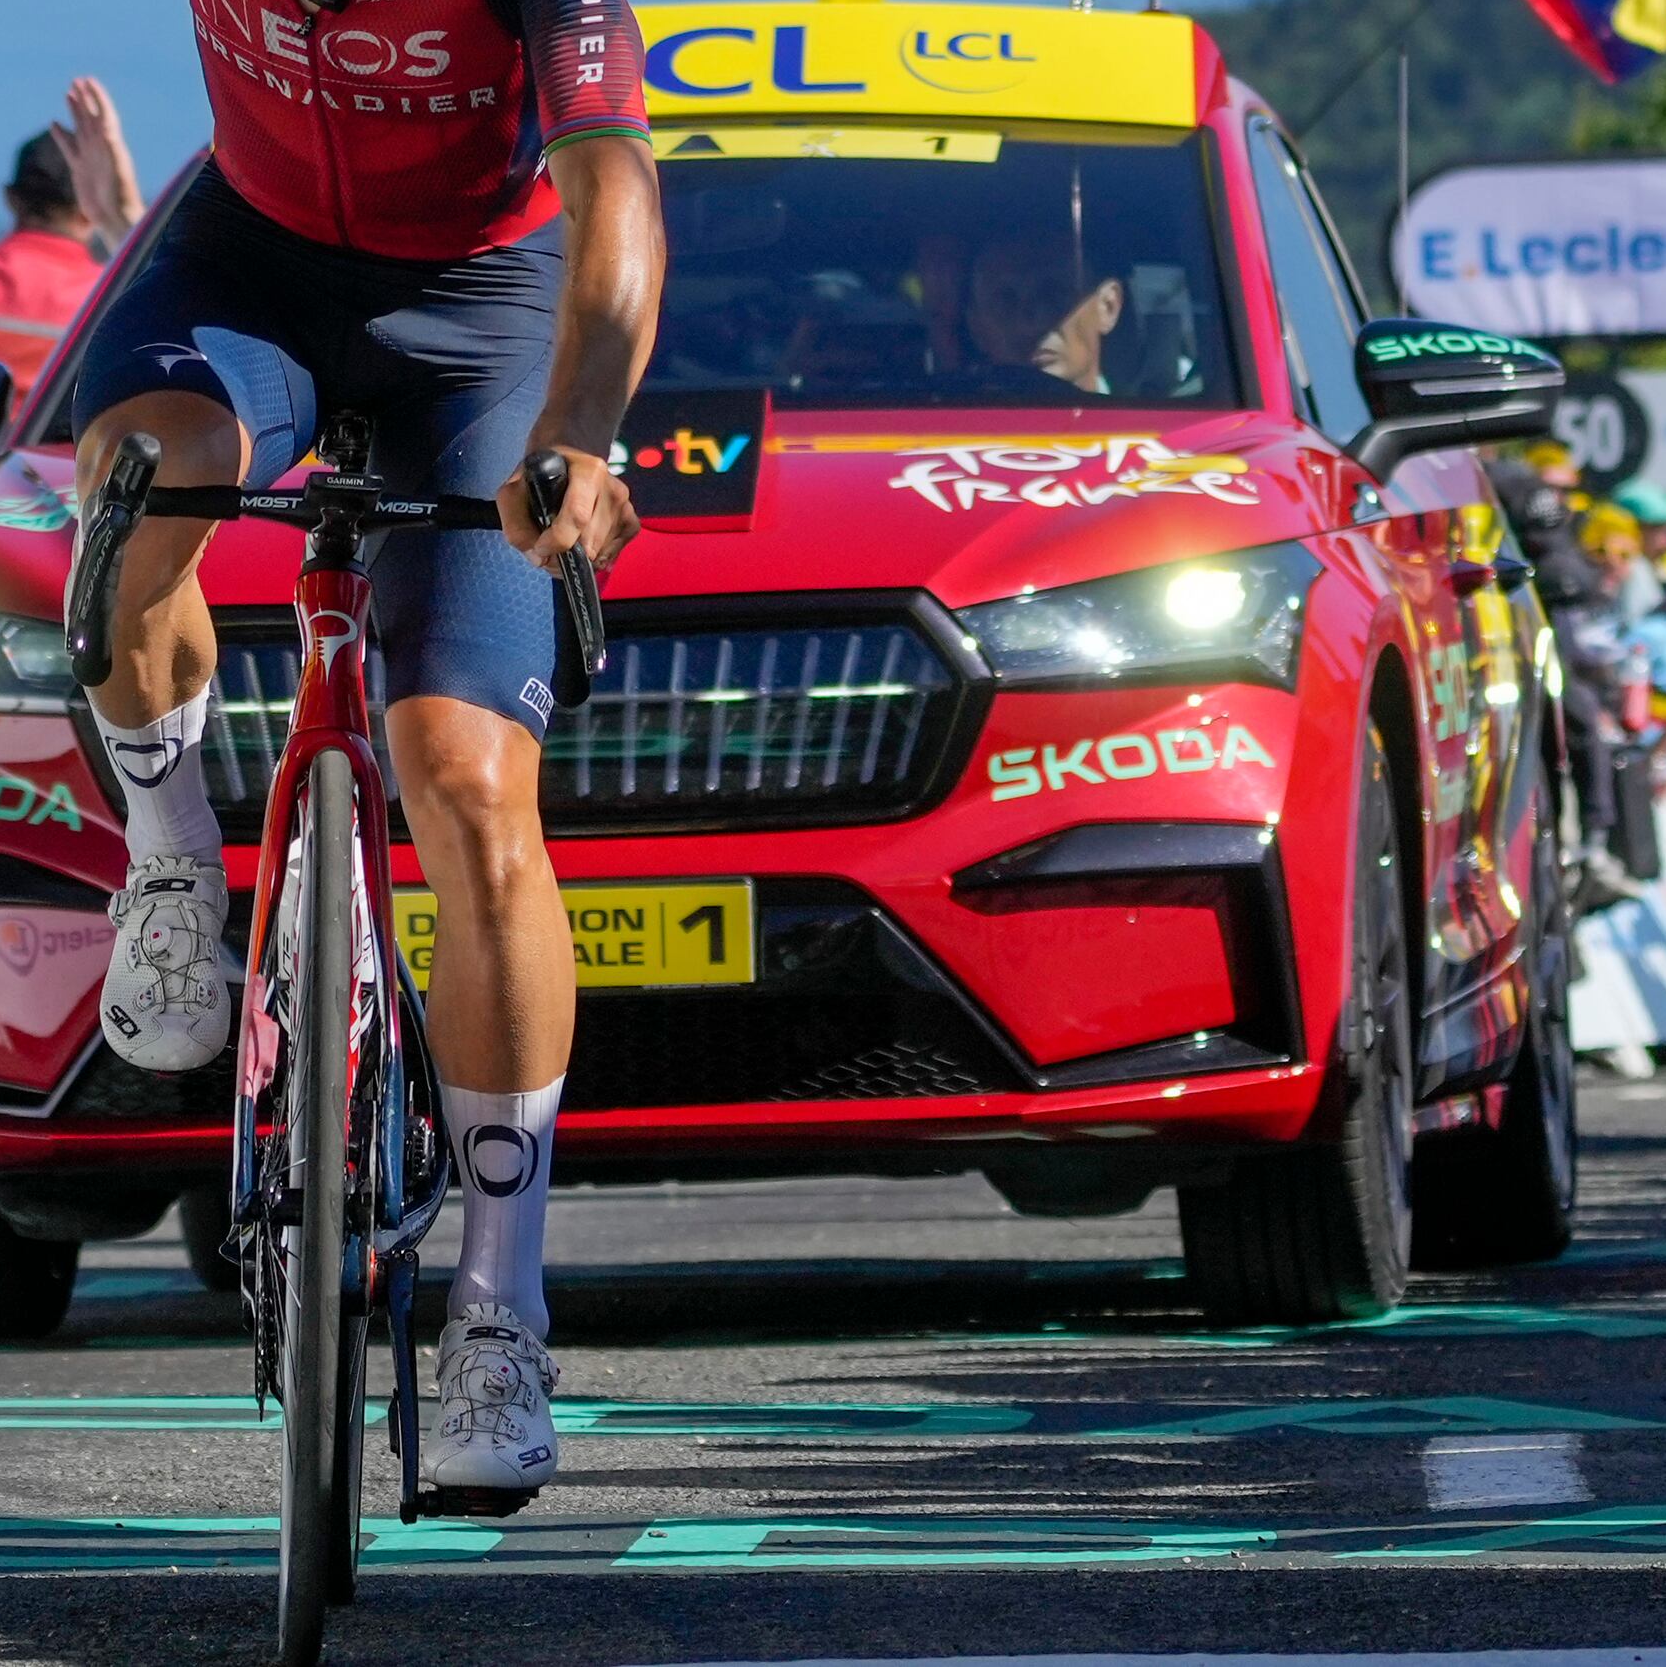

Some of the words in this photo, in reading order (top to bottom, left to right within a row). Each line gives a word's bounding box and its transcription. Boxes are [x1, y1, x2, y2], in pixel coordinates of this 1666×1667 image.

[195, 12, 496, 114] GRENADIER
[644, 25, 867, 97] CL
[915, 31, 1037, 62] LCL
[326, 476, 364, 487] GARMIN
[678, 905, 725, 965] 1
